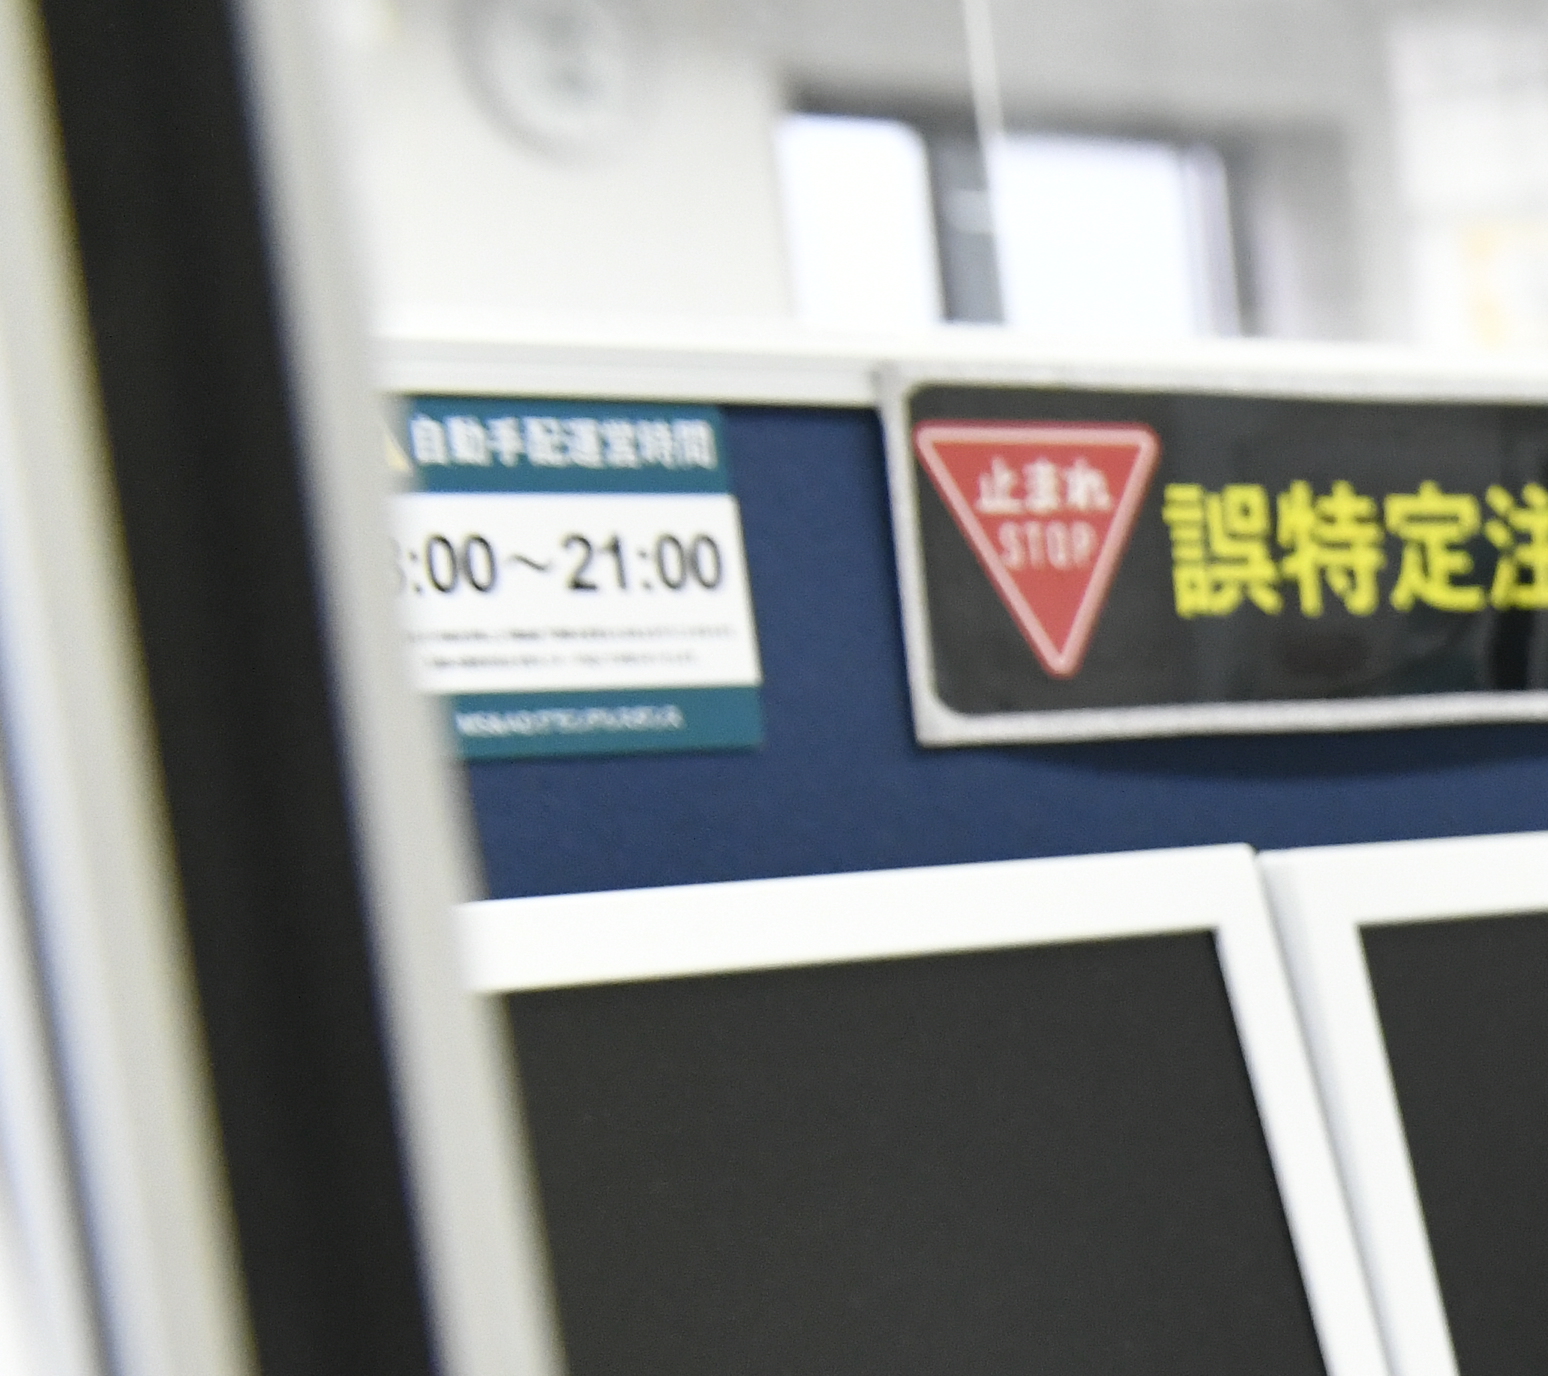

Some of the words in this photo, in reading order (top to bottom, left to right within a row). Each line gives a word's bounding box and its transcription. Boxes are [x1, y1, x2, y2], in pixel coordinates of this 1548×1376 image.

[976, 456, 1112, 514] 止まれ
[999, 521, 1097, 571] STOP
